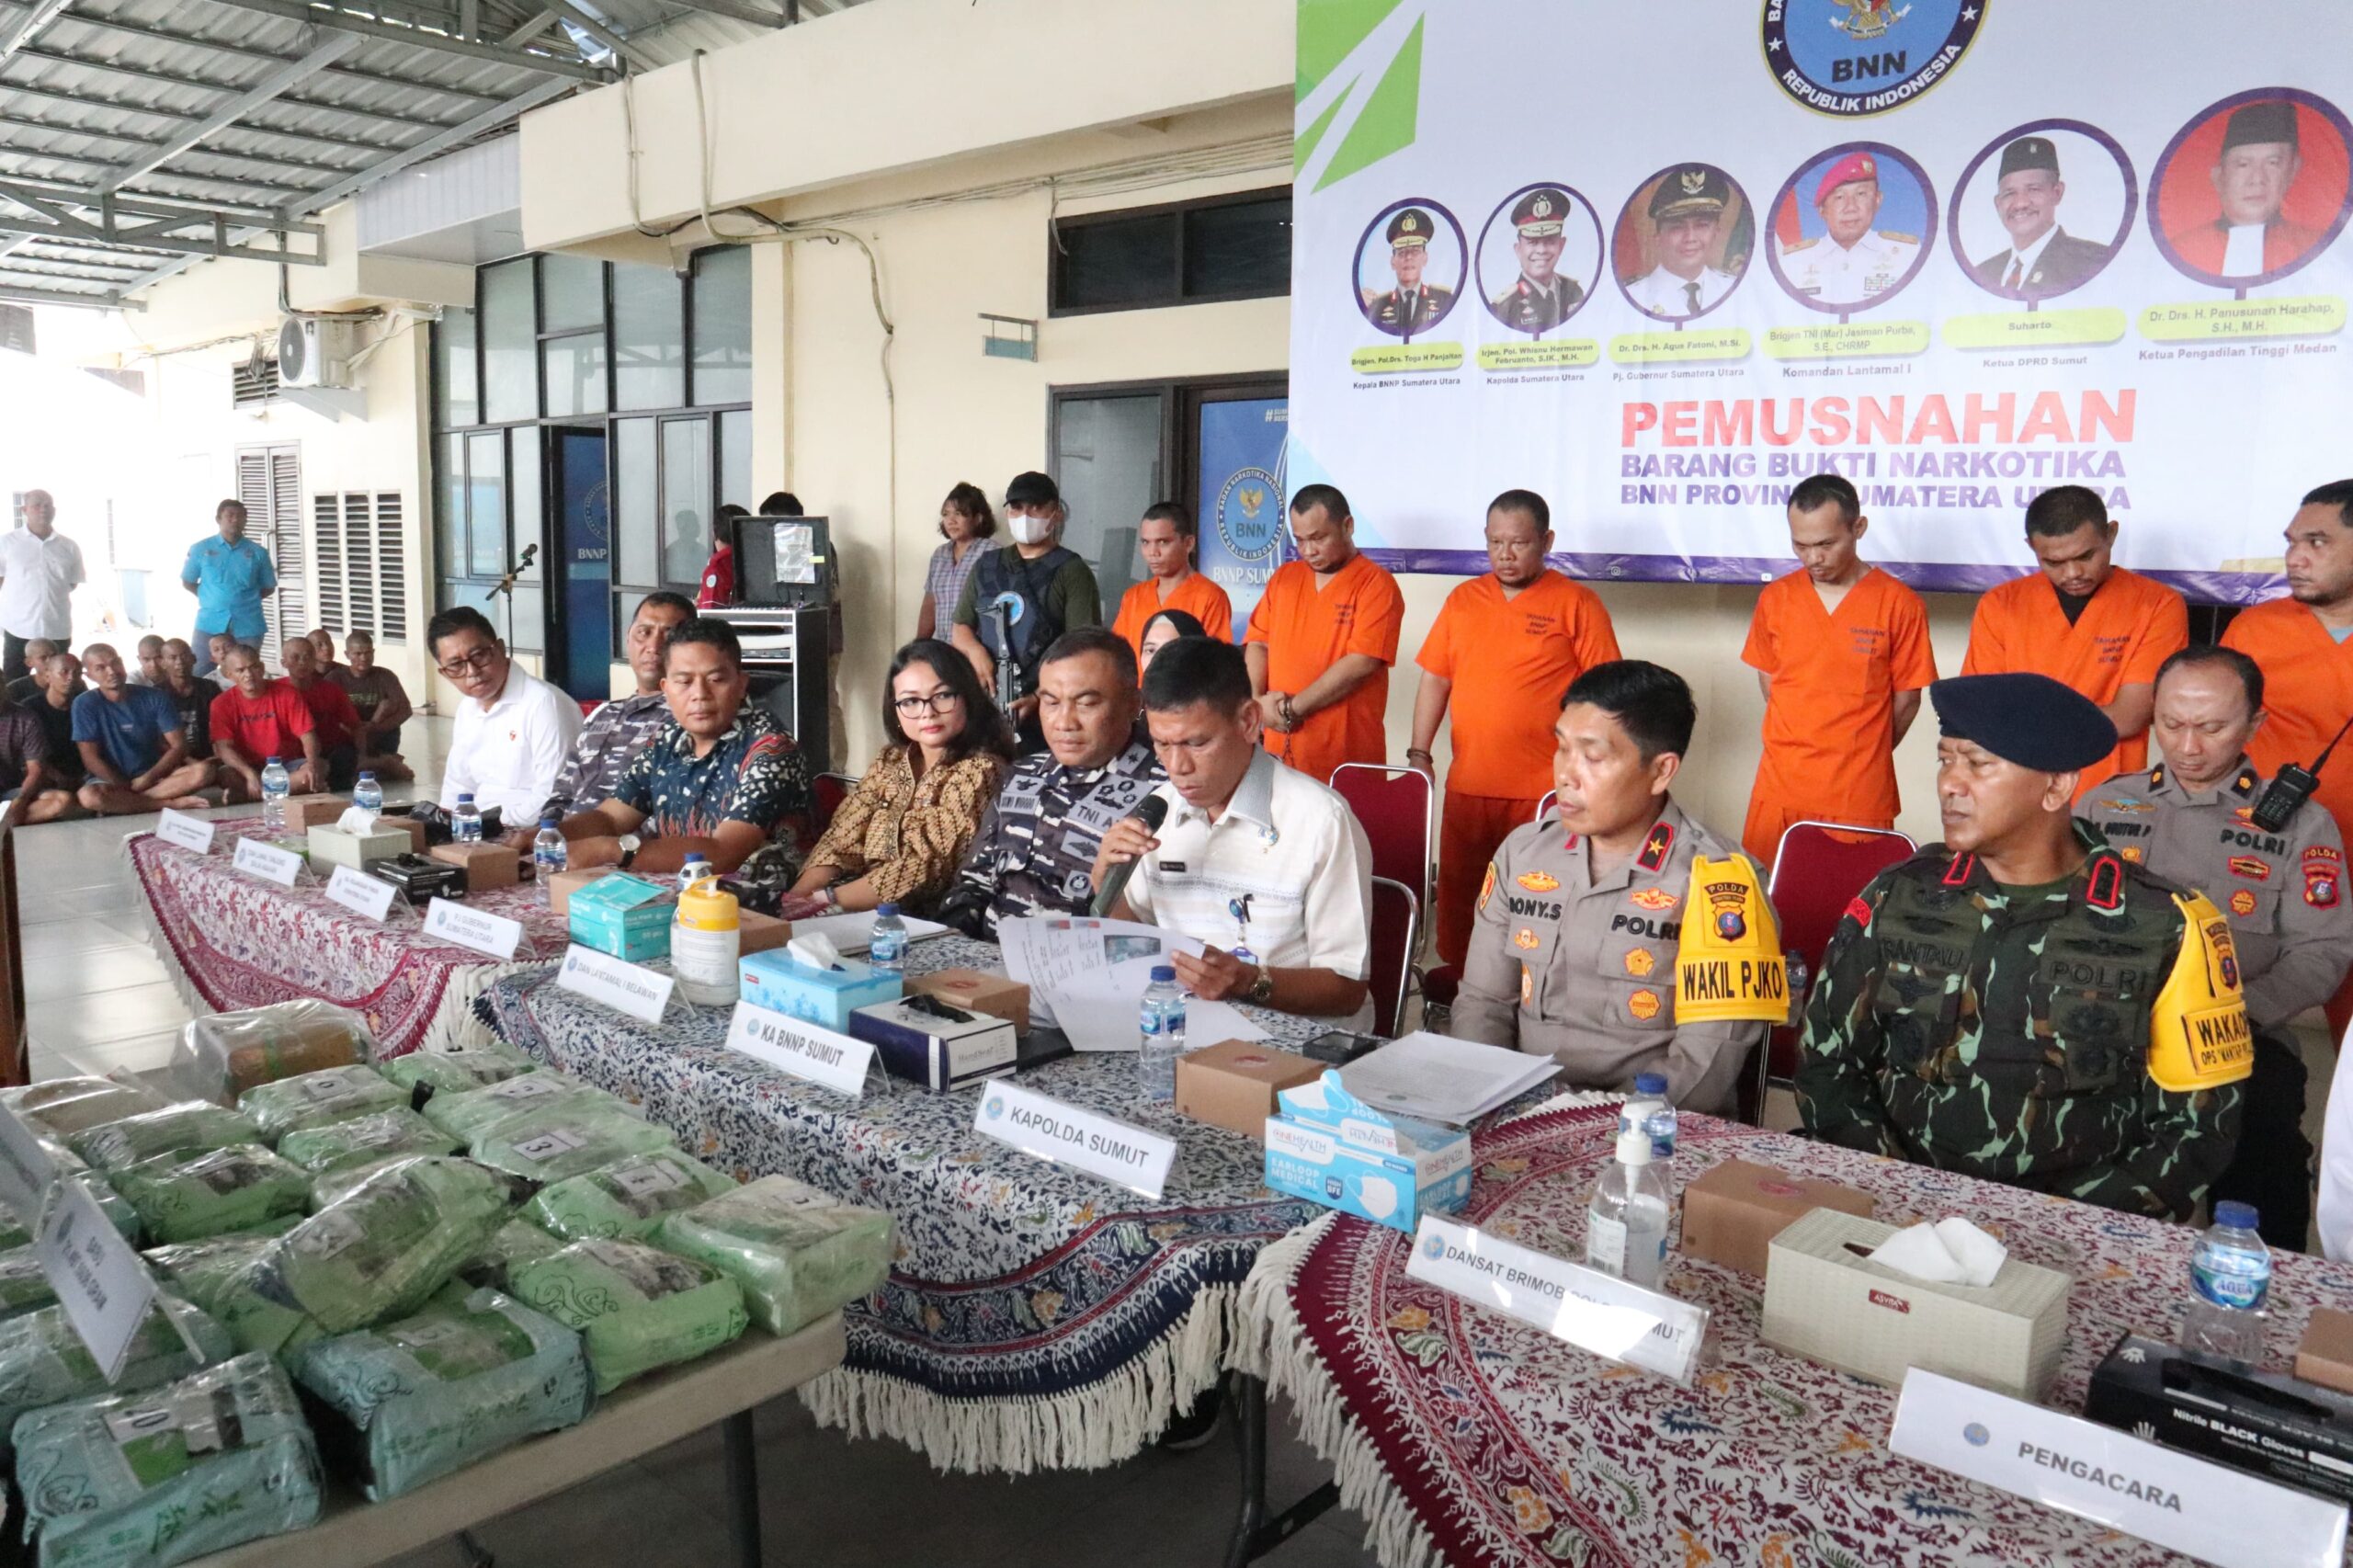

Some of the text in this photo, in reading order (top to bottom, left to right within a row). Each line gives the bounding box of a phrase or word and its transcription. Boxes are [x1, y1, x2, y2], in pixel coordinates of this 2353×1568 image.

[1831, 51, 1907, 84] BNN
[1782, 45, 1962, 111] REPUBLIK INDONESIA
[2149, 302, 2335, 322] Dr. Drs. H. Panusunan Harahap,
[1769, 325, 1916, 343] Brigjen TNI (Mar) Jasiman Purba,
[2008, 321, 2052, 331] Suharto
[2211, 320, 2268, 334] S.H., M.H.
[1481, 349, 1502, 358] Irjen.
[1503, 347, 1518, 356] Pol.
[1550, 344, 1594, 353] Hermawan
[1619, 345, 1631, 353] Dr.
[1632, 343, 1650, 352] Drs.
[1652, 343, 1662, 351] H.
[1663, 342, 1685, 352] Agus
[1687, 340, 1718, 351] Fatoni,
[1836, 340, 1871, 351] CHRMP
[2139, 342, 2337, 361] Ketua Pengadilan Tinggi Medan
[1404, 355, 1422, 365] Toga
[1430, 353, 1462, 363] Panjaitan
[1983, 355, 2088, 368] Ketua DPRD Sumut
[1486, 373, 1585, 386] Kapolda Sumatera Utara
[1612, 368, 1745, 382] Pj. Gubernur Sumatera Utara
[1782, 364, 1912, 378] Komandan Lantamal I
[1353, 377, 1461, 391] Kepala BNNP Sumatera Utara
[1620, 389, 2137, 448] PEMUSNAHAN
[1620, 449, 2126, 478] BARANG BUKTI NARKOTIKA
[1219, 470, 1284, 511] BADAN NARKOTIKA NASIONAL
[1620, 484, 1677, 506] BNN
[1686, 484, 1790, 506] PROVIN
[1235, 523, 1267, 538] BNN
[577, 548, 608, 560] BNNP
[1213, 566, 1275, 584] BNNP SUM
[1077, 805, 1100, 824] TNI
[2221, 829, 2286, 856] POLRI
[2304, 847, 2337, 860] POLDA
[1708, 883, 1745, 893] POLDA
[577, 962, 591, 976] DAN
[625, 979, 659, 1002] BELAWAN
[1683, 961, 1735, 1001] WAKIL
[2049, 960, 2147, 993] POLRI
[760, 1023, 845, 1065] KA BNNP SUMUT
[1010, 1106, 1150, 1169] KAPOLDA SUMUT
[1271, 1156, 1320, 1177] EARLOOP
[1271, 1166, 1319, 1189] MEDICAL
[1446, 1245, 1506, 1278] DANSAT
[1506, 1267, 1566, 1300] BRIMOB
[2216, 1279, 2253, 1296] AQUA
[2173, 1408, 2208, 1427] Nitrile
[2210, 1419, 2257, 1444] BLACK
[2261, 1436, 2304, 1459] Gloves
[2018, 1440, 2182, 1513] PENGACARA
